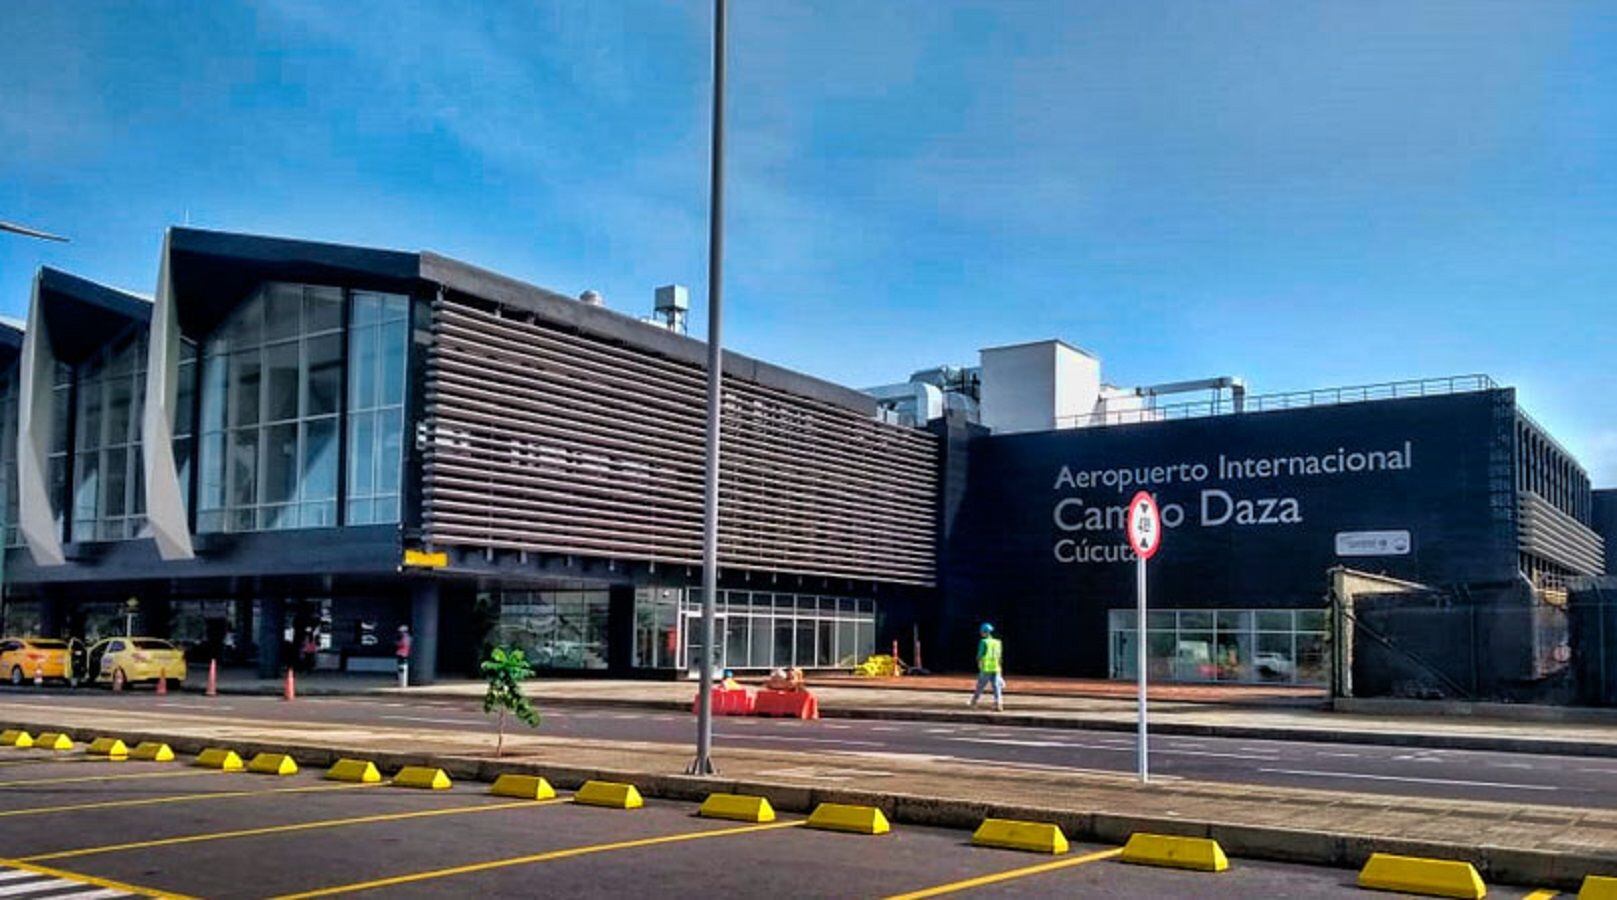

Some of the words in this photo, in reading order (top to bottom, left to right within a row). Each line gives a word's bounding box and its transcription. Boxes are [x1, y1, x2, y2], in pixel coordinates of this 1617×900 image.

[1054, 463, 1209, 493] Aeropuerto
[1219, 441, 1411, 480] Internacional
[1054, 493, 1185, 531] Camo
[1200, 489, 1303, 527] Daza
